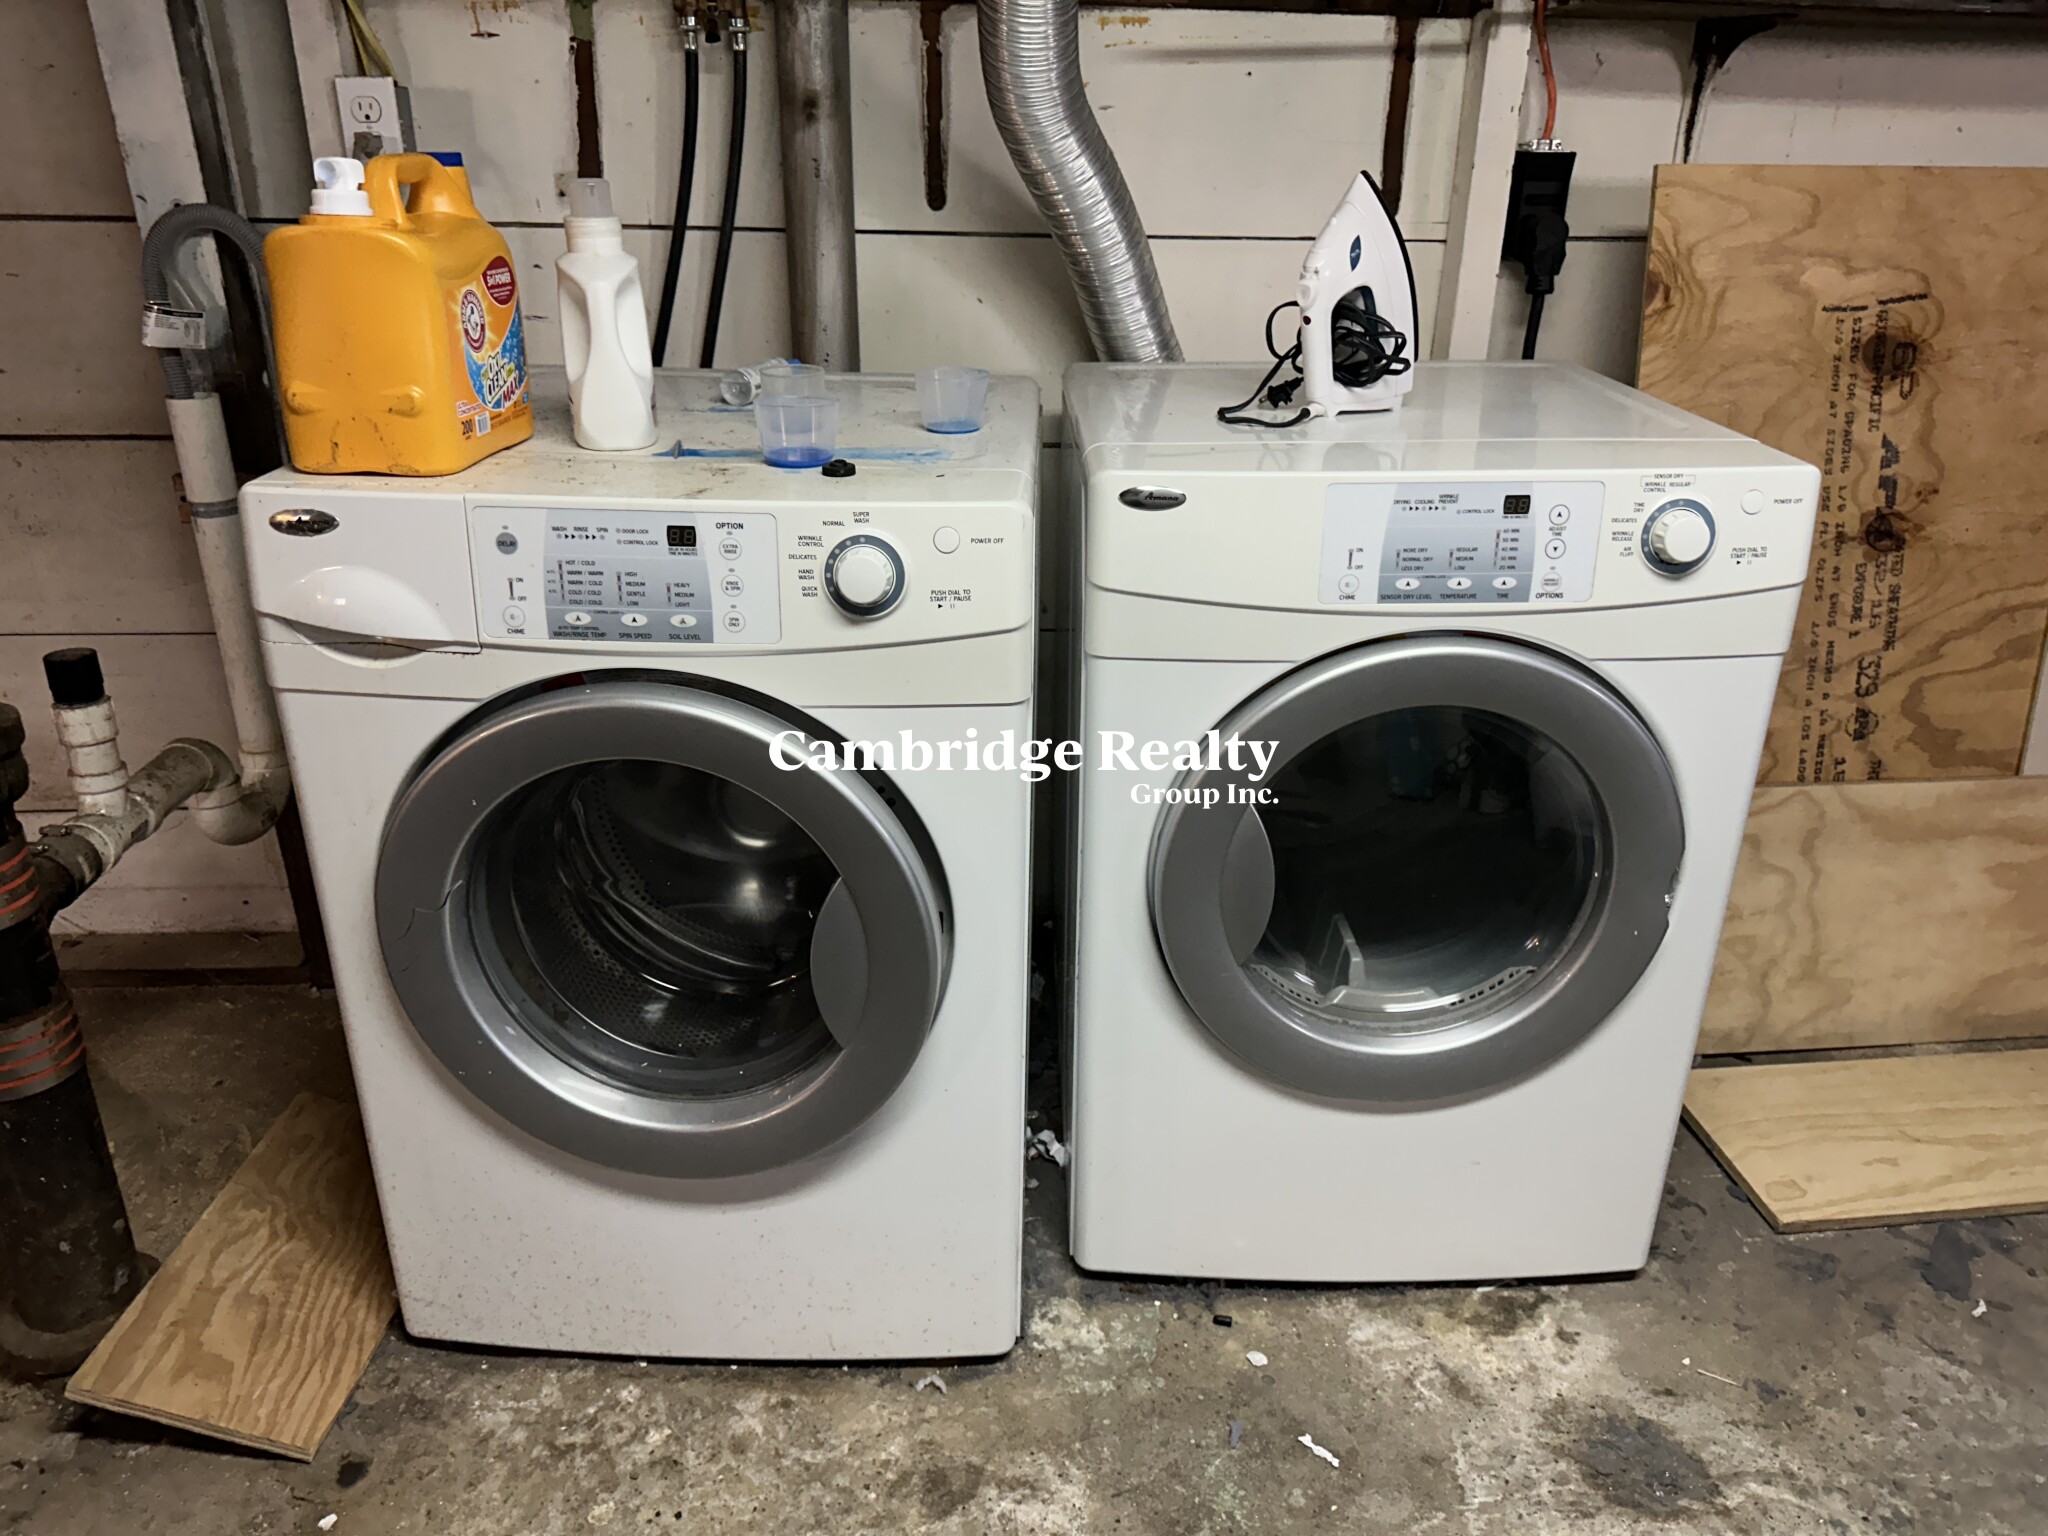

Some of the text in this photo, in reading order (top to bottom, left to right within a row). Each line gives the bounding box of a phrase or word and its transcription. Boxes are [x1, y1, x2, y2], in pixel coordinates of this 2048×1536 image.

[495, 271, 512, 285] POWER
[488, 351, 501, 379] OXI
[487, 361, 507, 404] CLEAN
[502, 370, 521, 410] MAX
[1846, 373, 1856, 401] FOR
[461, 418, 474, 436] 200
[1144, 491, 1179, 501] Amana
[1821, 485, 1831, 512] USE
[715, 522, 744, 530] OPTION
[1832, 565, 1841, 582] AT
[1850, 562, 1868, 624] EXPOSURE
